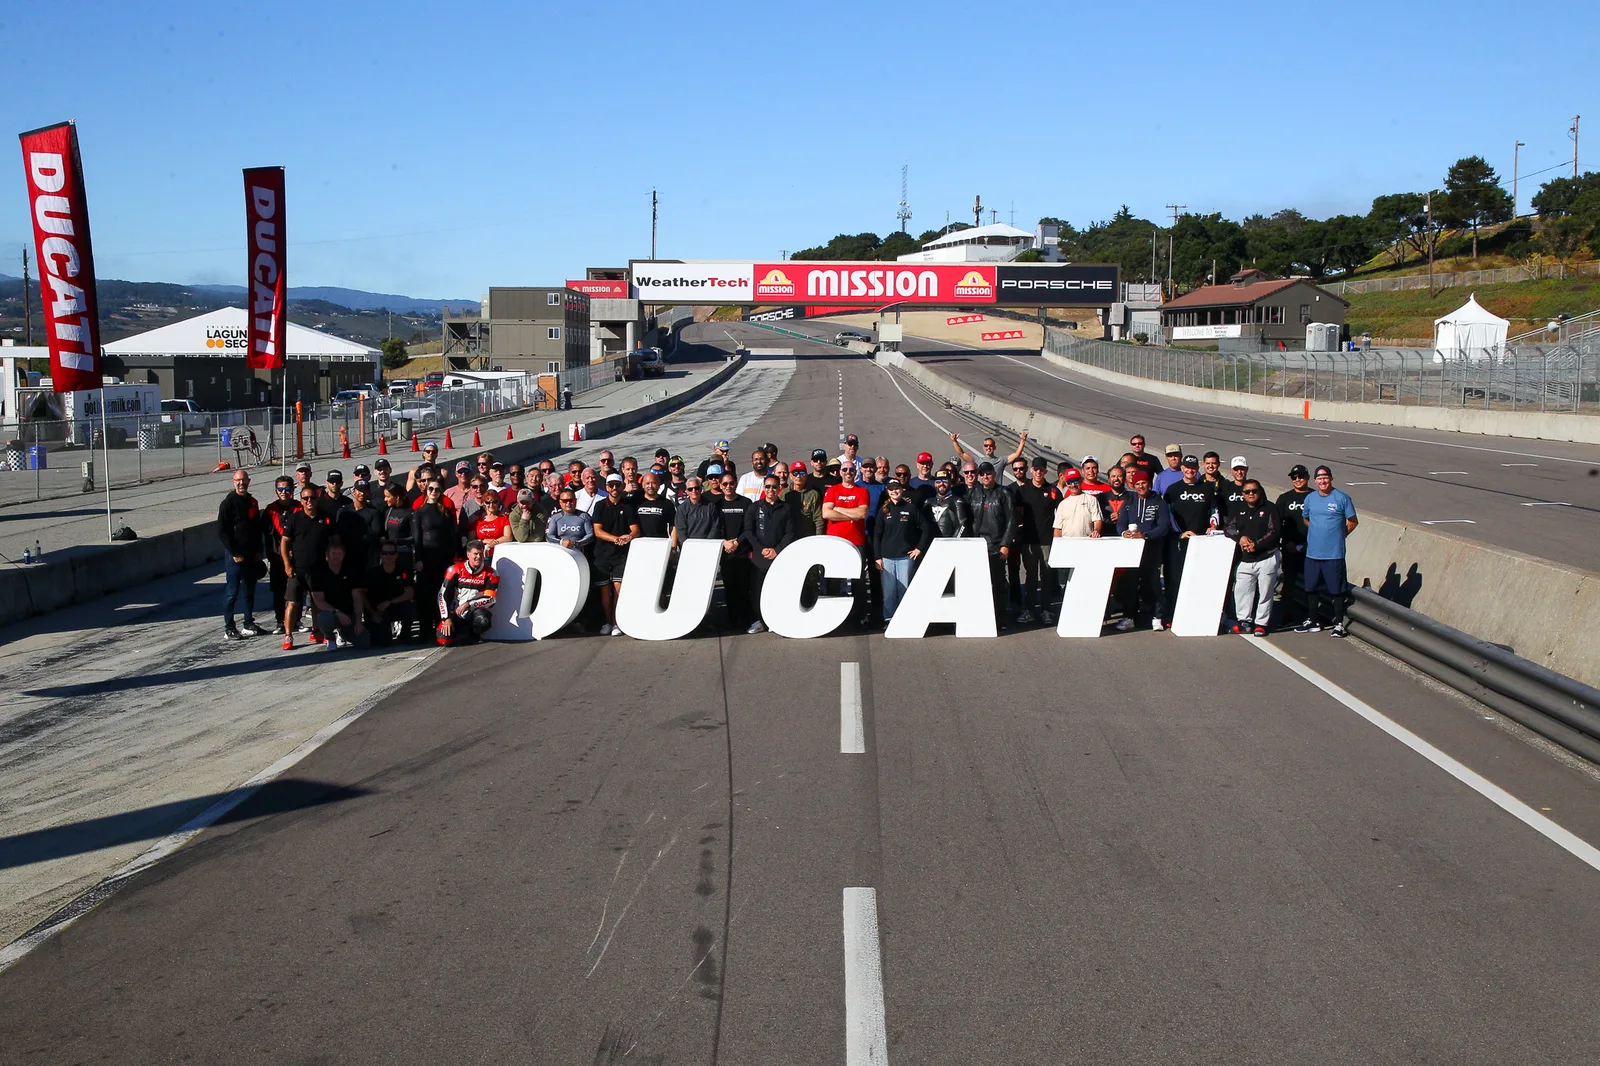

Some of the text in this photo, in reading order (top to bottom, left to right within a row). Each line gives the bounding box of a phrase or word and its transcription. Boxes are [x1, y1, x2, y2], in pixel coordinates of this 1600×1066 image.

[30, 152, 94, 372] DUCATI
[252, 185, 277, 355] DUCATI
[636, 276, 750, 288] WeatherTech
[807, 269, 938, 297] MISSION
[1002, 280, 1112, 290] PORSCHE
[758, 285, 793, 294] MISSION
[956, 287, 990, 296] MISSION
[750, 308, 794, 322] PORSCHE
[206, 330, 248, 338] LAGUN
[224, 340, 248, 348] SEC
[1180, 490, 1204, 500] droc
[1228, 492, 1244, 502] dro
[560, 524, 580, 532] droc
[482, 534, 1235, 641] DUCATI
